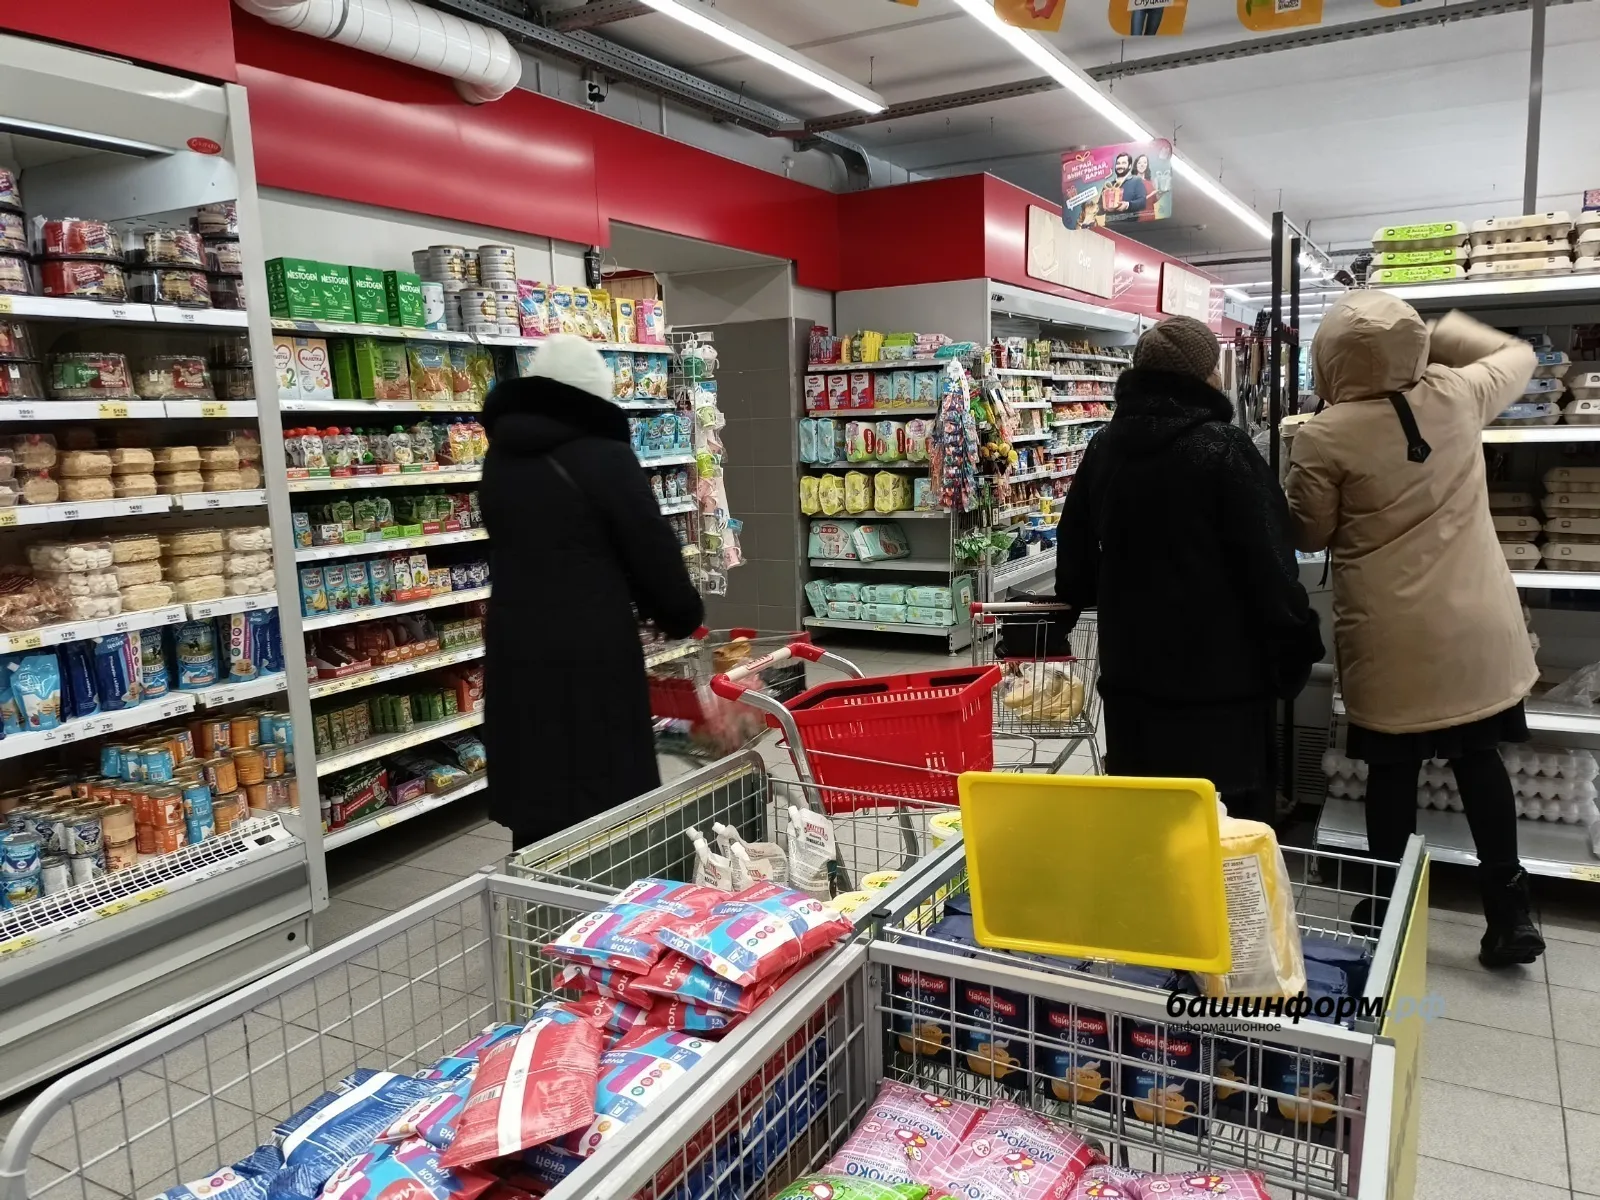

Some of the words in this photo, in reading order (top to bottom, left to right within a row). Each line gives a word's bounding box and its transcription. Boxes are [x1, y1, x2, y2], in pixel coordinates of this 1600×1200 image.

[1071, 161, 1094, 172] ИГРАЙ,
[287, 269, 318, 281] NESTOGEN
[321, 273, 349, 285] NESTOGEN
[355, 279, 383, 290] NESTOGEN
[663, 955, 687, 987] Моло
[898, 973, 945, 989] Чайфский
[968, 990, 1013, 1012] Чайкоский
[1051, 1014, 1104, 1030] Чайкфский
[877, 1111, 943, 1141] МОЛОКО
[535, 1155, 566, 1173] цена
